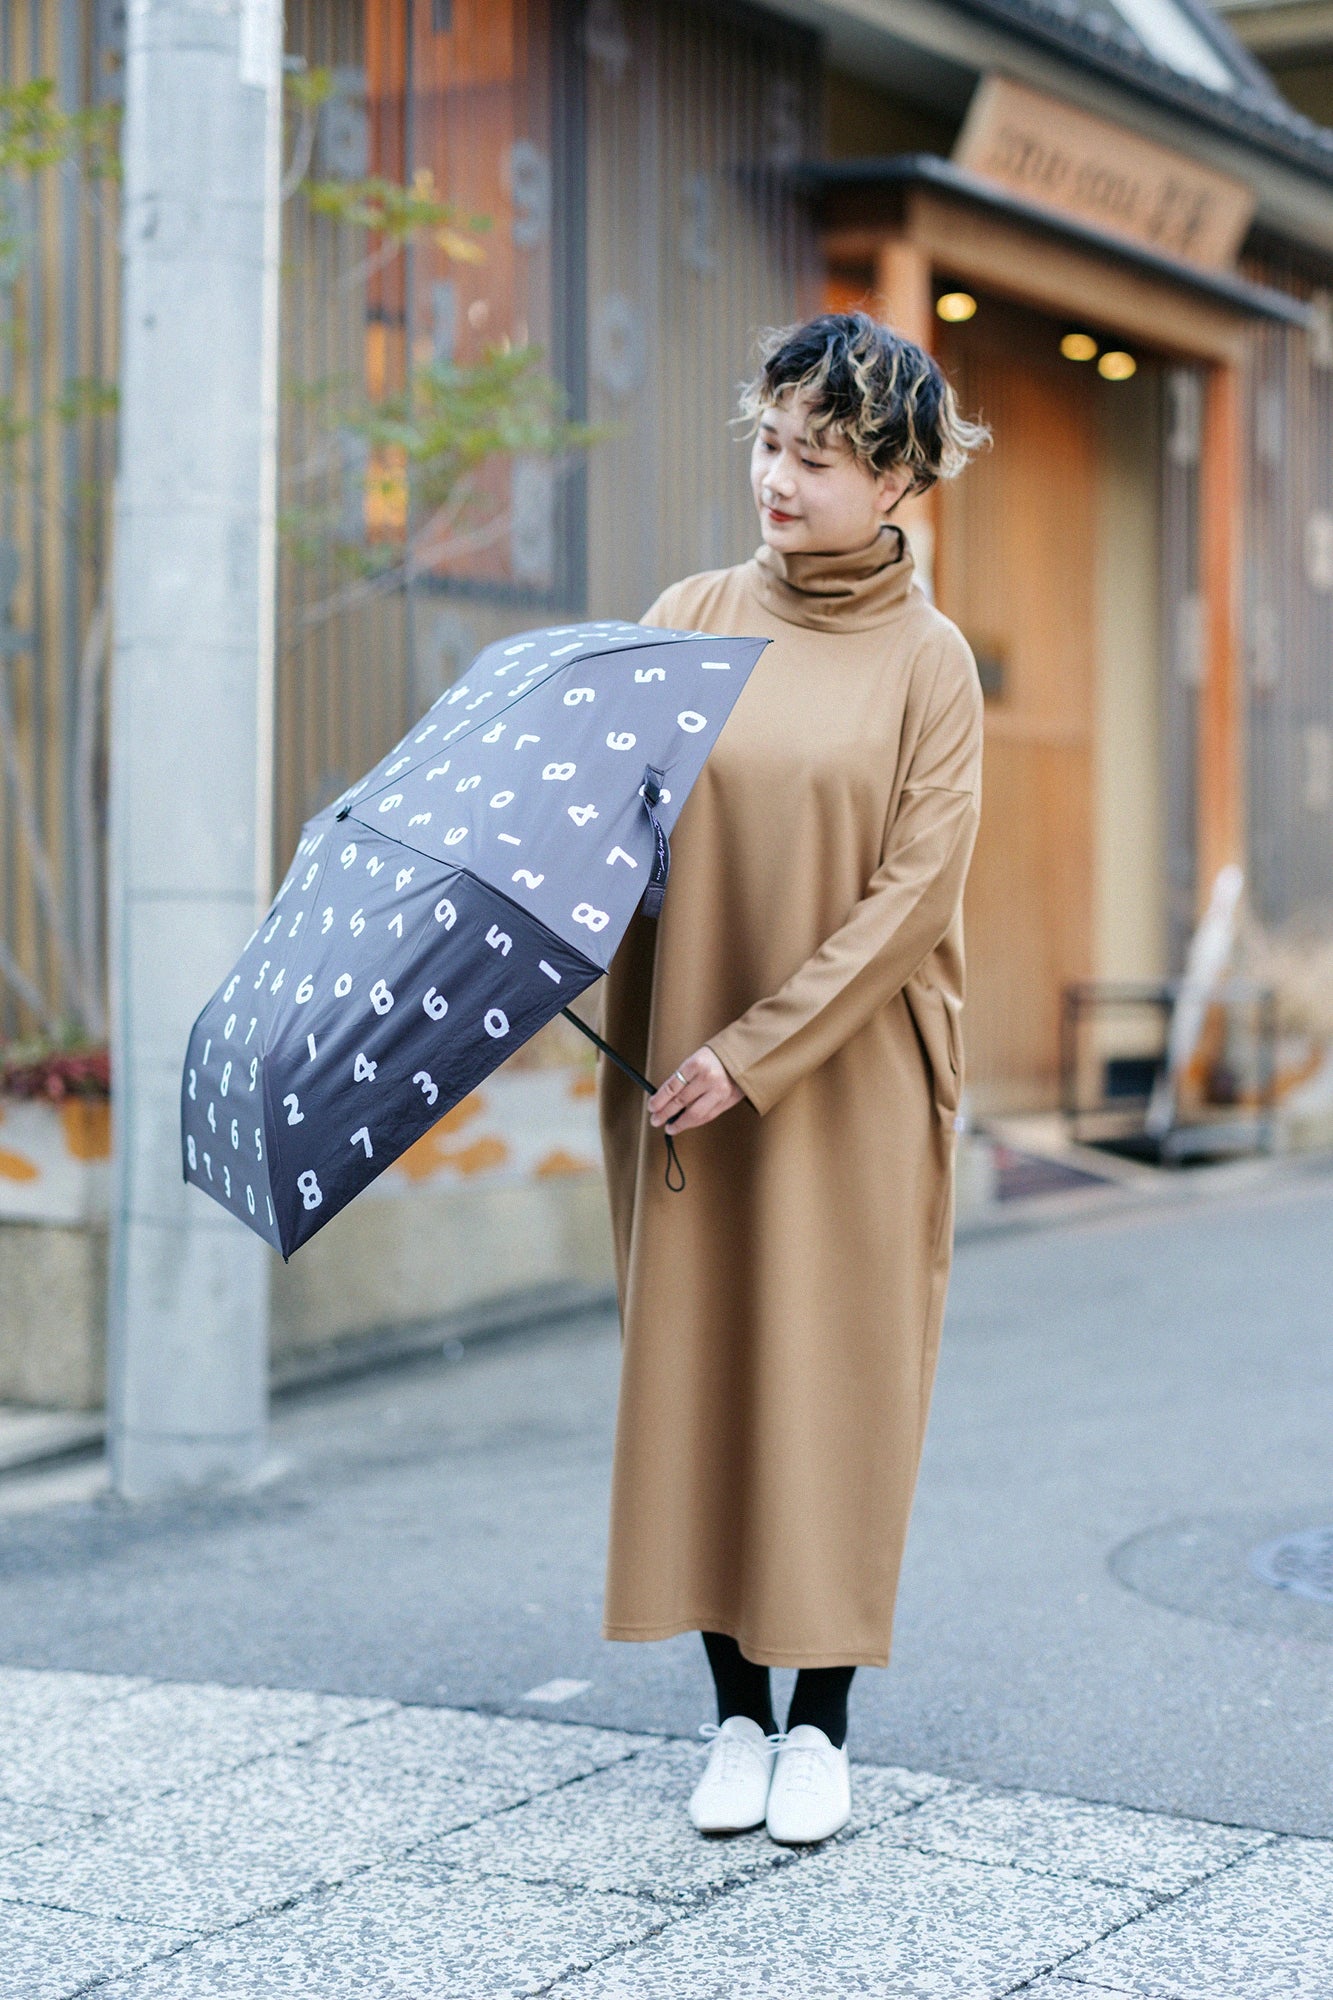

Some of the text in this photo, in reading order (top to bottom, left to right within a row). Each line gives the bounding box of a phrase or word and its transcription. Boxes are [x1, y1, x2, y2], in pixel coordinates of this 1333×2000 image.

[634, 667, 666, 683] 5
[701, 661, 731, 670] 1
[676, 710, 708, 734] 0
[455, 775, 482, 793] 5
[542, 762, 577, 781] 8
[489, 790, 515, 809] 0
[407, 812, 432, 827] 3
[567, 803, 600, 827] 4
[497, 833, 522, 846] 1
[340, 842, 357, 870] 9
[366, 855, 385, 878] 2
[606, 845, 638, 869] 7
[395, 866, 416, 892] 4
[511, 869, 545, 890] 2
[321, 906, 334, 935] 3
[349, 908, 366, 938] 5
[387, 912, 403, 939] 7
[434, 898, 458, 932] 9
[571, 902, 610, 933] 8
[484, 923, 513, 957] 5
[270, 968, 286, 996] 4
[334, 972, 353, 998] 0
[538, 959, 562, 985] 1
[223, 974, 241, 1003] 6
[295, 974, 314, 1005] 6
[369, 978, 395, 1016] 8
[422, 986, 449, 1021] 6
[223, 1013, 237, 1040] 0
[483, 1007, 510, 1039] 0
[202, 1038, 212, 1066] 1
[306, 1033, 318, 1062] 1
[220, 1060, 233, 1097] 8
[353, 1052, 378, 1083] 4
[412, 1070, 439, 1106] 3
[207, 1101, 217, 1134] 4
[282, 1092, 305, 1126] 2
[230, 1118, 239, 1150] 6
[254, 1127, 263, 1162] 5
[349, 1126, 374, 1159] 7
[187, 1134, 197, 1170] 8
[246, 1184, 256, 1216] 0
[296, 1169, 324, 1211] 8
[265, 1195, 274, 1226] 1
